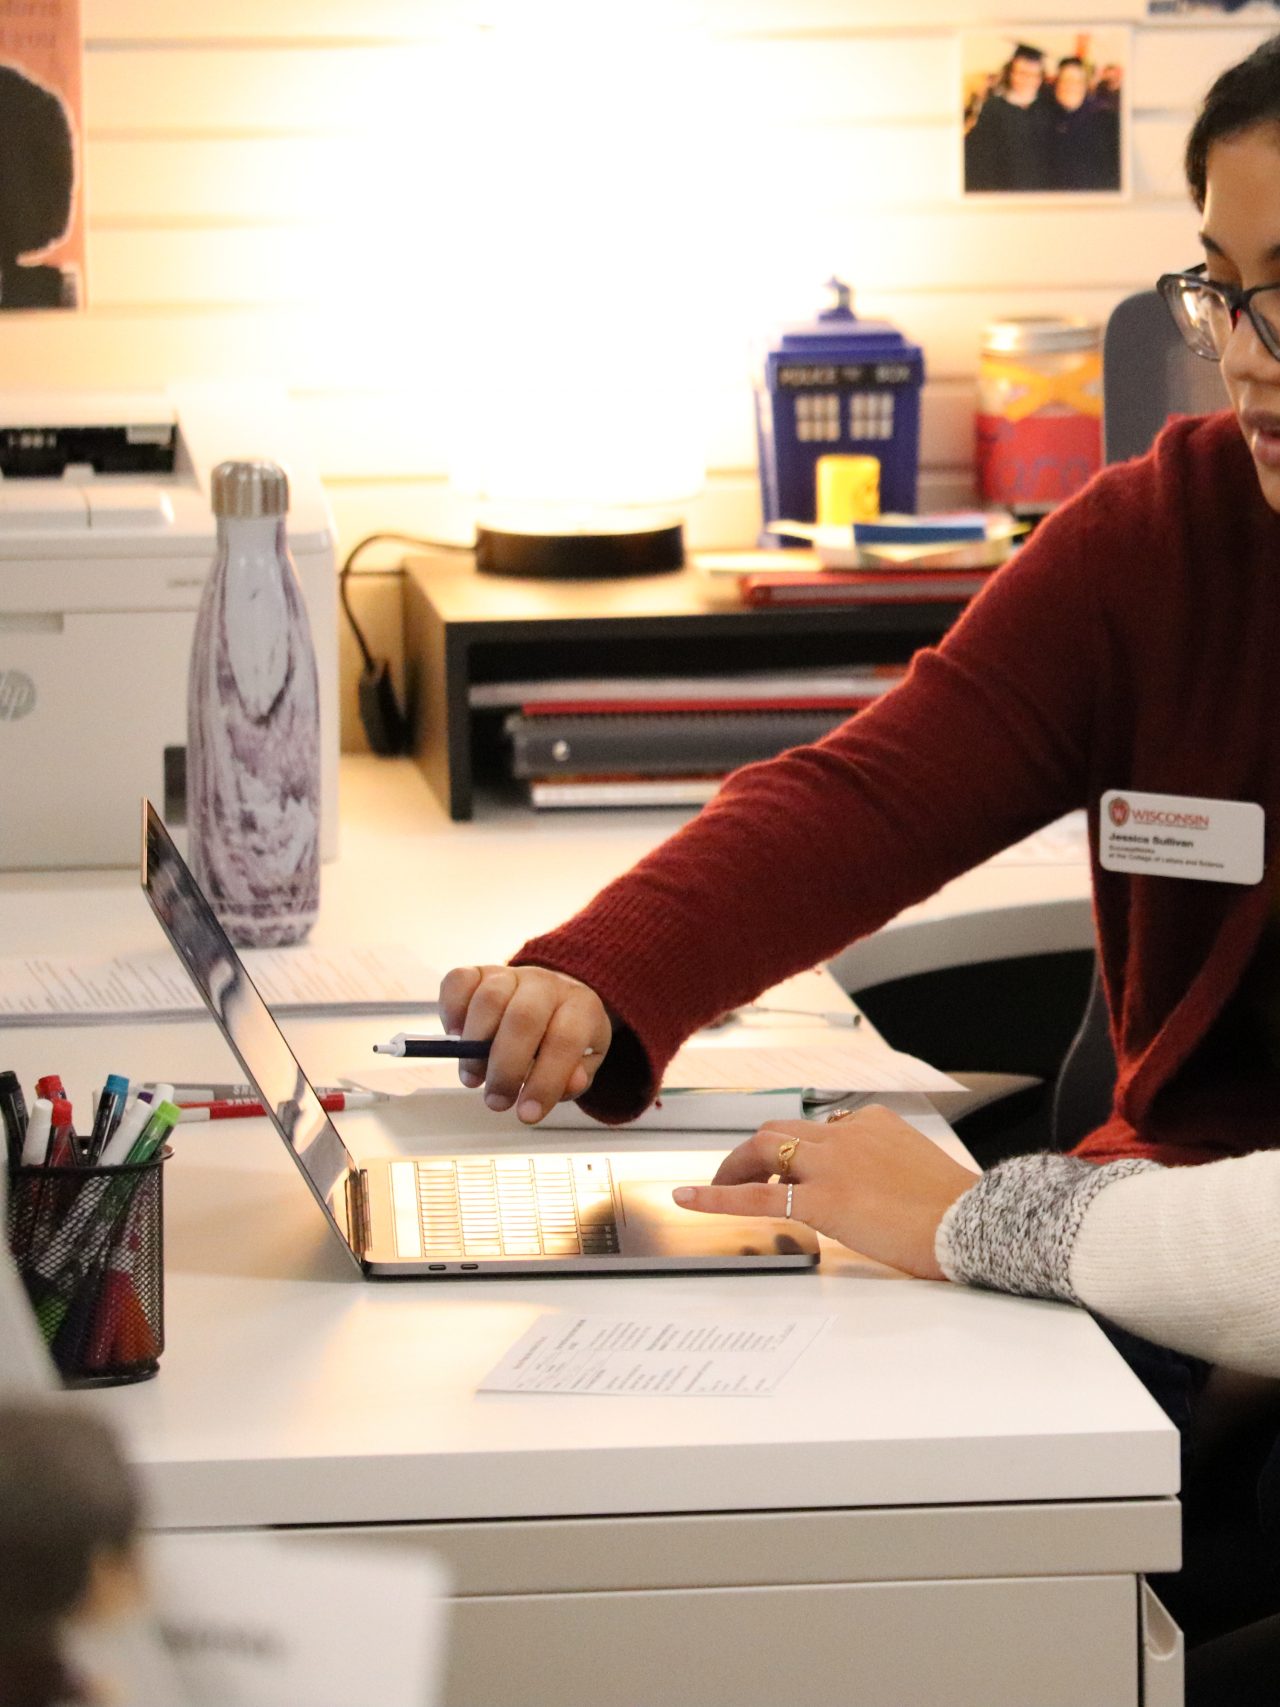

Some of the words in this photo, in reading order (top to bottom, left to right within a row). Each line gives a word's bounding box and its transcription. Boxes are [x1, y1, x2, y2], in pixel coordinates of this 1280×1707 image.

[1131, 808, 1210, 827] WISCONSIN
[1109, 833, 1150, 845] Jessica
[1152, 836, 1194, 848] Sullivan
